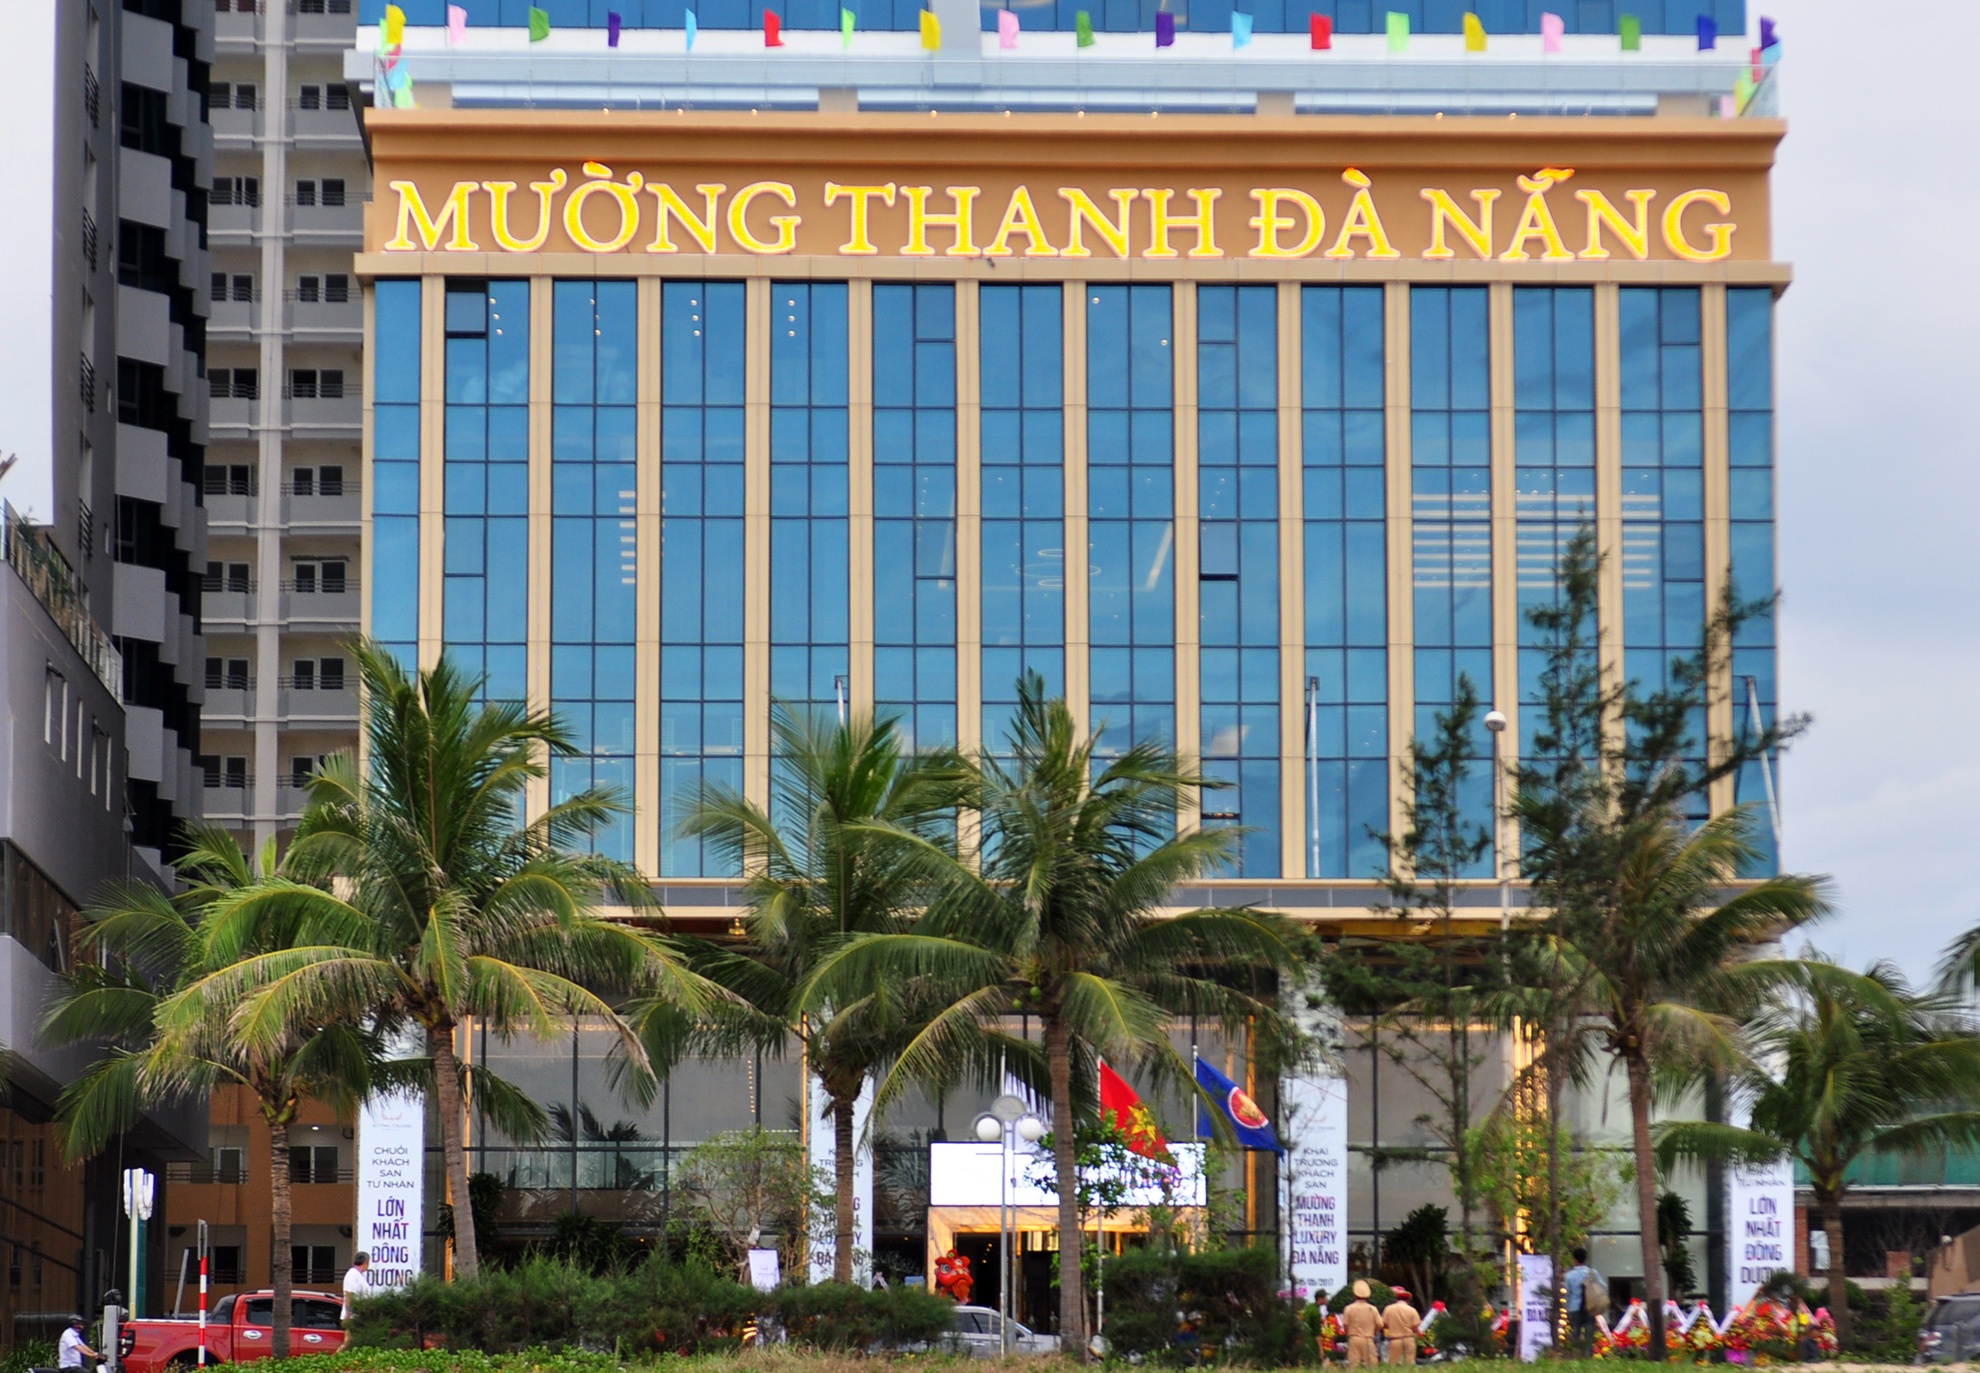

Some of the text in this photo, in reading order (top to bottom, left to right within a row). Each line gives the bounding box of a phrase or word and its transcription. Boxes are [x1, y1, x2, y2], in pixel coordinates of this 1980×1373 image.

[385, 160, 803, 256] MƯỜNG
[823, 181, 1224, 259] THANH
[1249, 166, 1401, 260] ĐÀ
[1303, 1147, 1329, 1156] KHAI
[377, 1195, 405, 1217] LỚN
[372, 1216, 410, 1240] NHẤT
[1297, 1213, 1335, 1227] THANH
[1294, 1230, 1338, 1245] LUXURY
[371, 1241, 409, 1264] ĐÔNG
